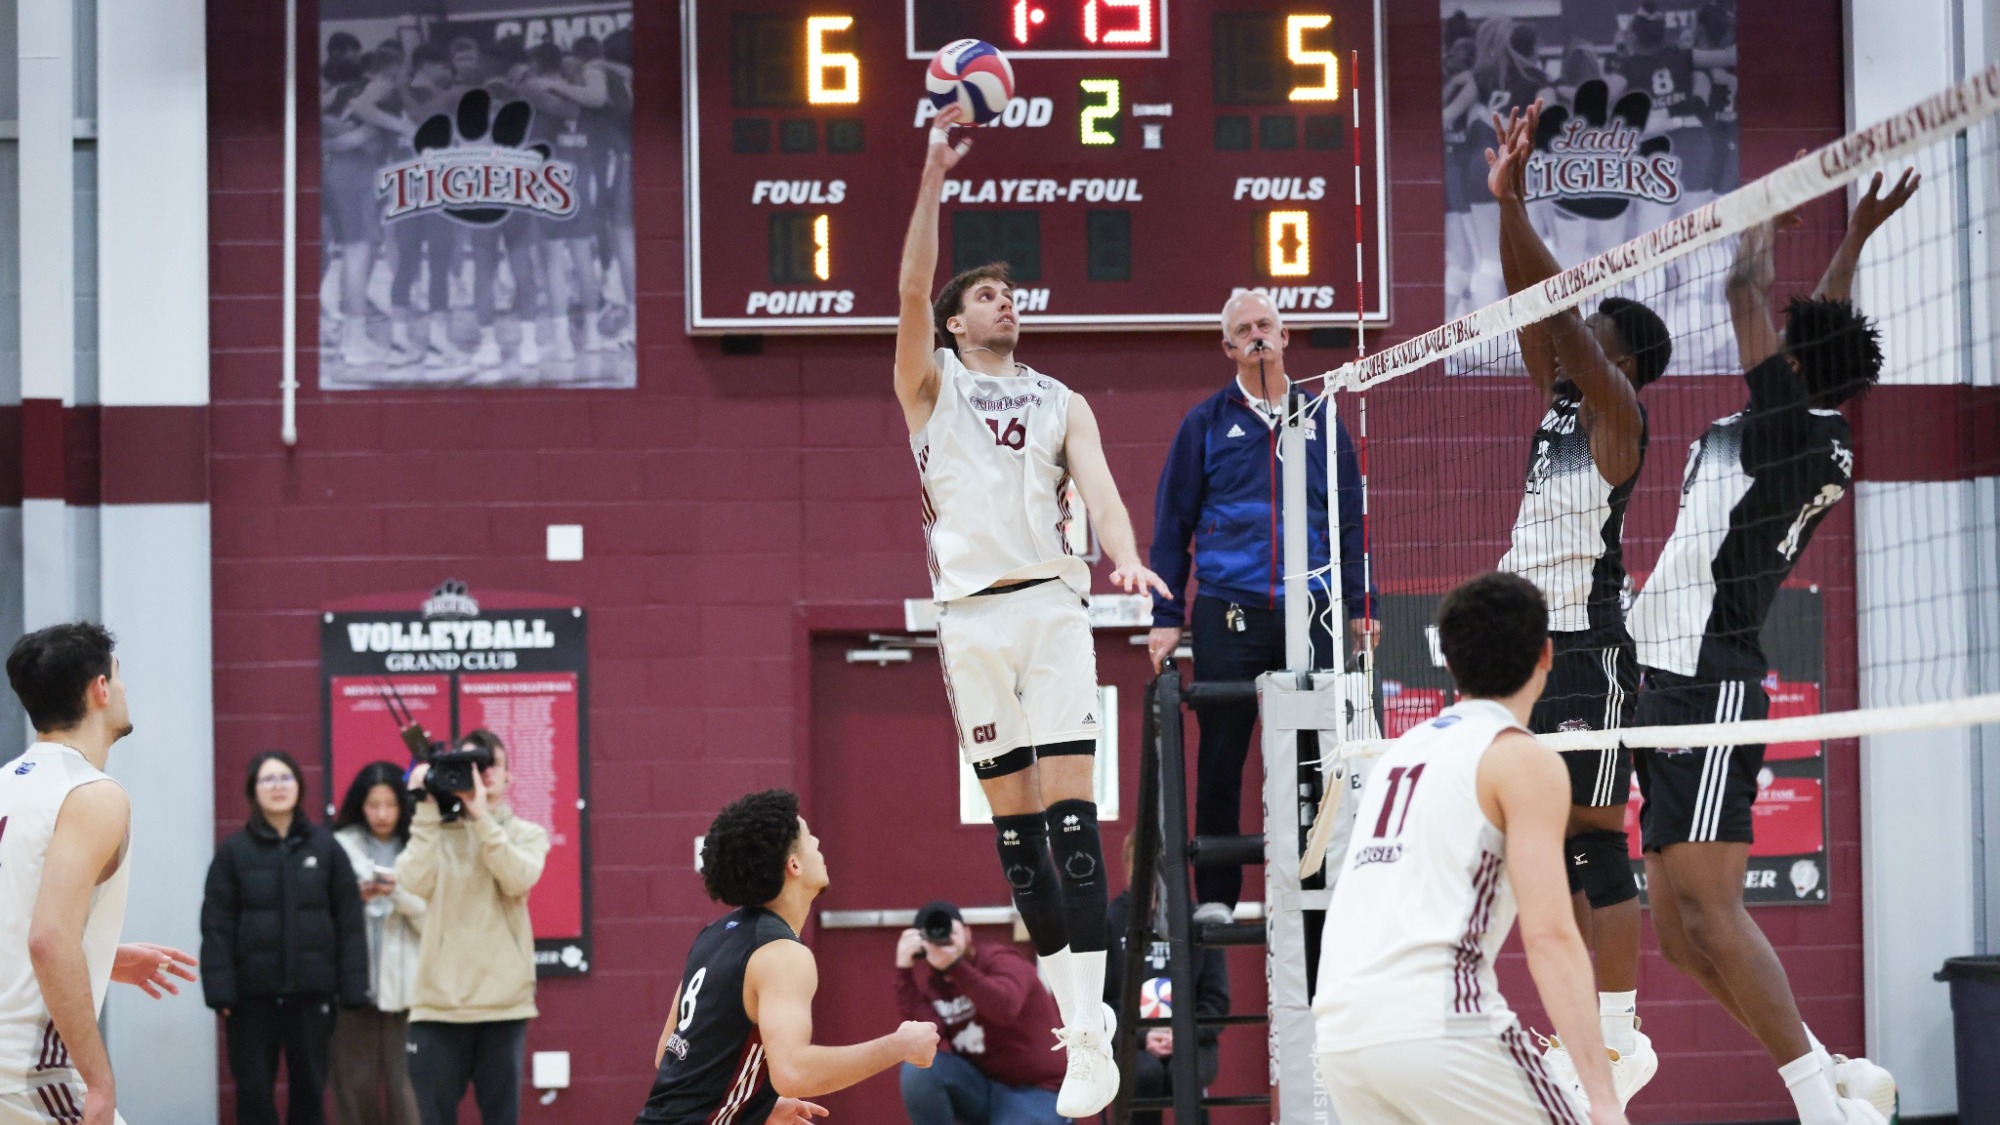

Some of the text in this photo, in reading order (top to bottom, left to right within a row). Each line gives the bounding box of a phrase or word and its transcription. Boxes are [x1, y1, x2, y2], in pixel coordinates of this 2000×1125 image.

[806, 16, 860, 103] 6
[1287, 15, 1339, 101] 5
[914, 97, 1053, 128] POD
[1081, 79, 1120, 144] 2
[1554, 119, 1639, 161] Lady
[381, 161, 576, 215] TIGERS
[752, 180, 847, 205] FOULS
[939, 178, 1144, 203] PLAYER-FOUL
[1233, 177, 1327, 201] FOULS
[813, 213, 830, 281] 1
[1268, 211, 1310, 276] 0
[747, 290, 855, 315] POINTS
[985, 416, 1027, 451] 16
[347, 619, 555, 653] VOLLEYBALL
[385, 650, 518, 672] GRAND CLUB
[972, 721, 998, 744] CU
[1373, 763, 1428, 838] 11
[678, 967, 707, 1031] 8
